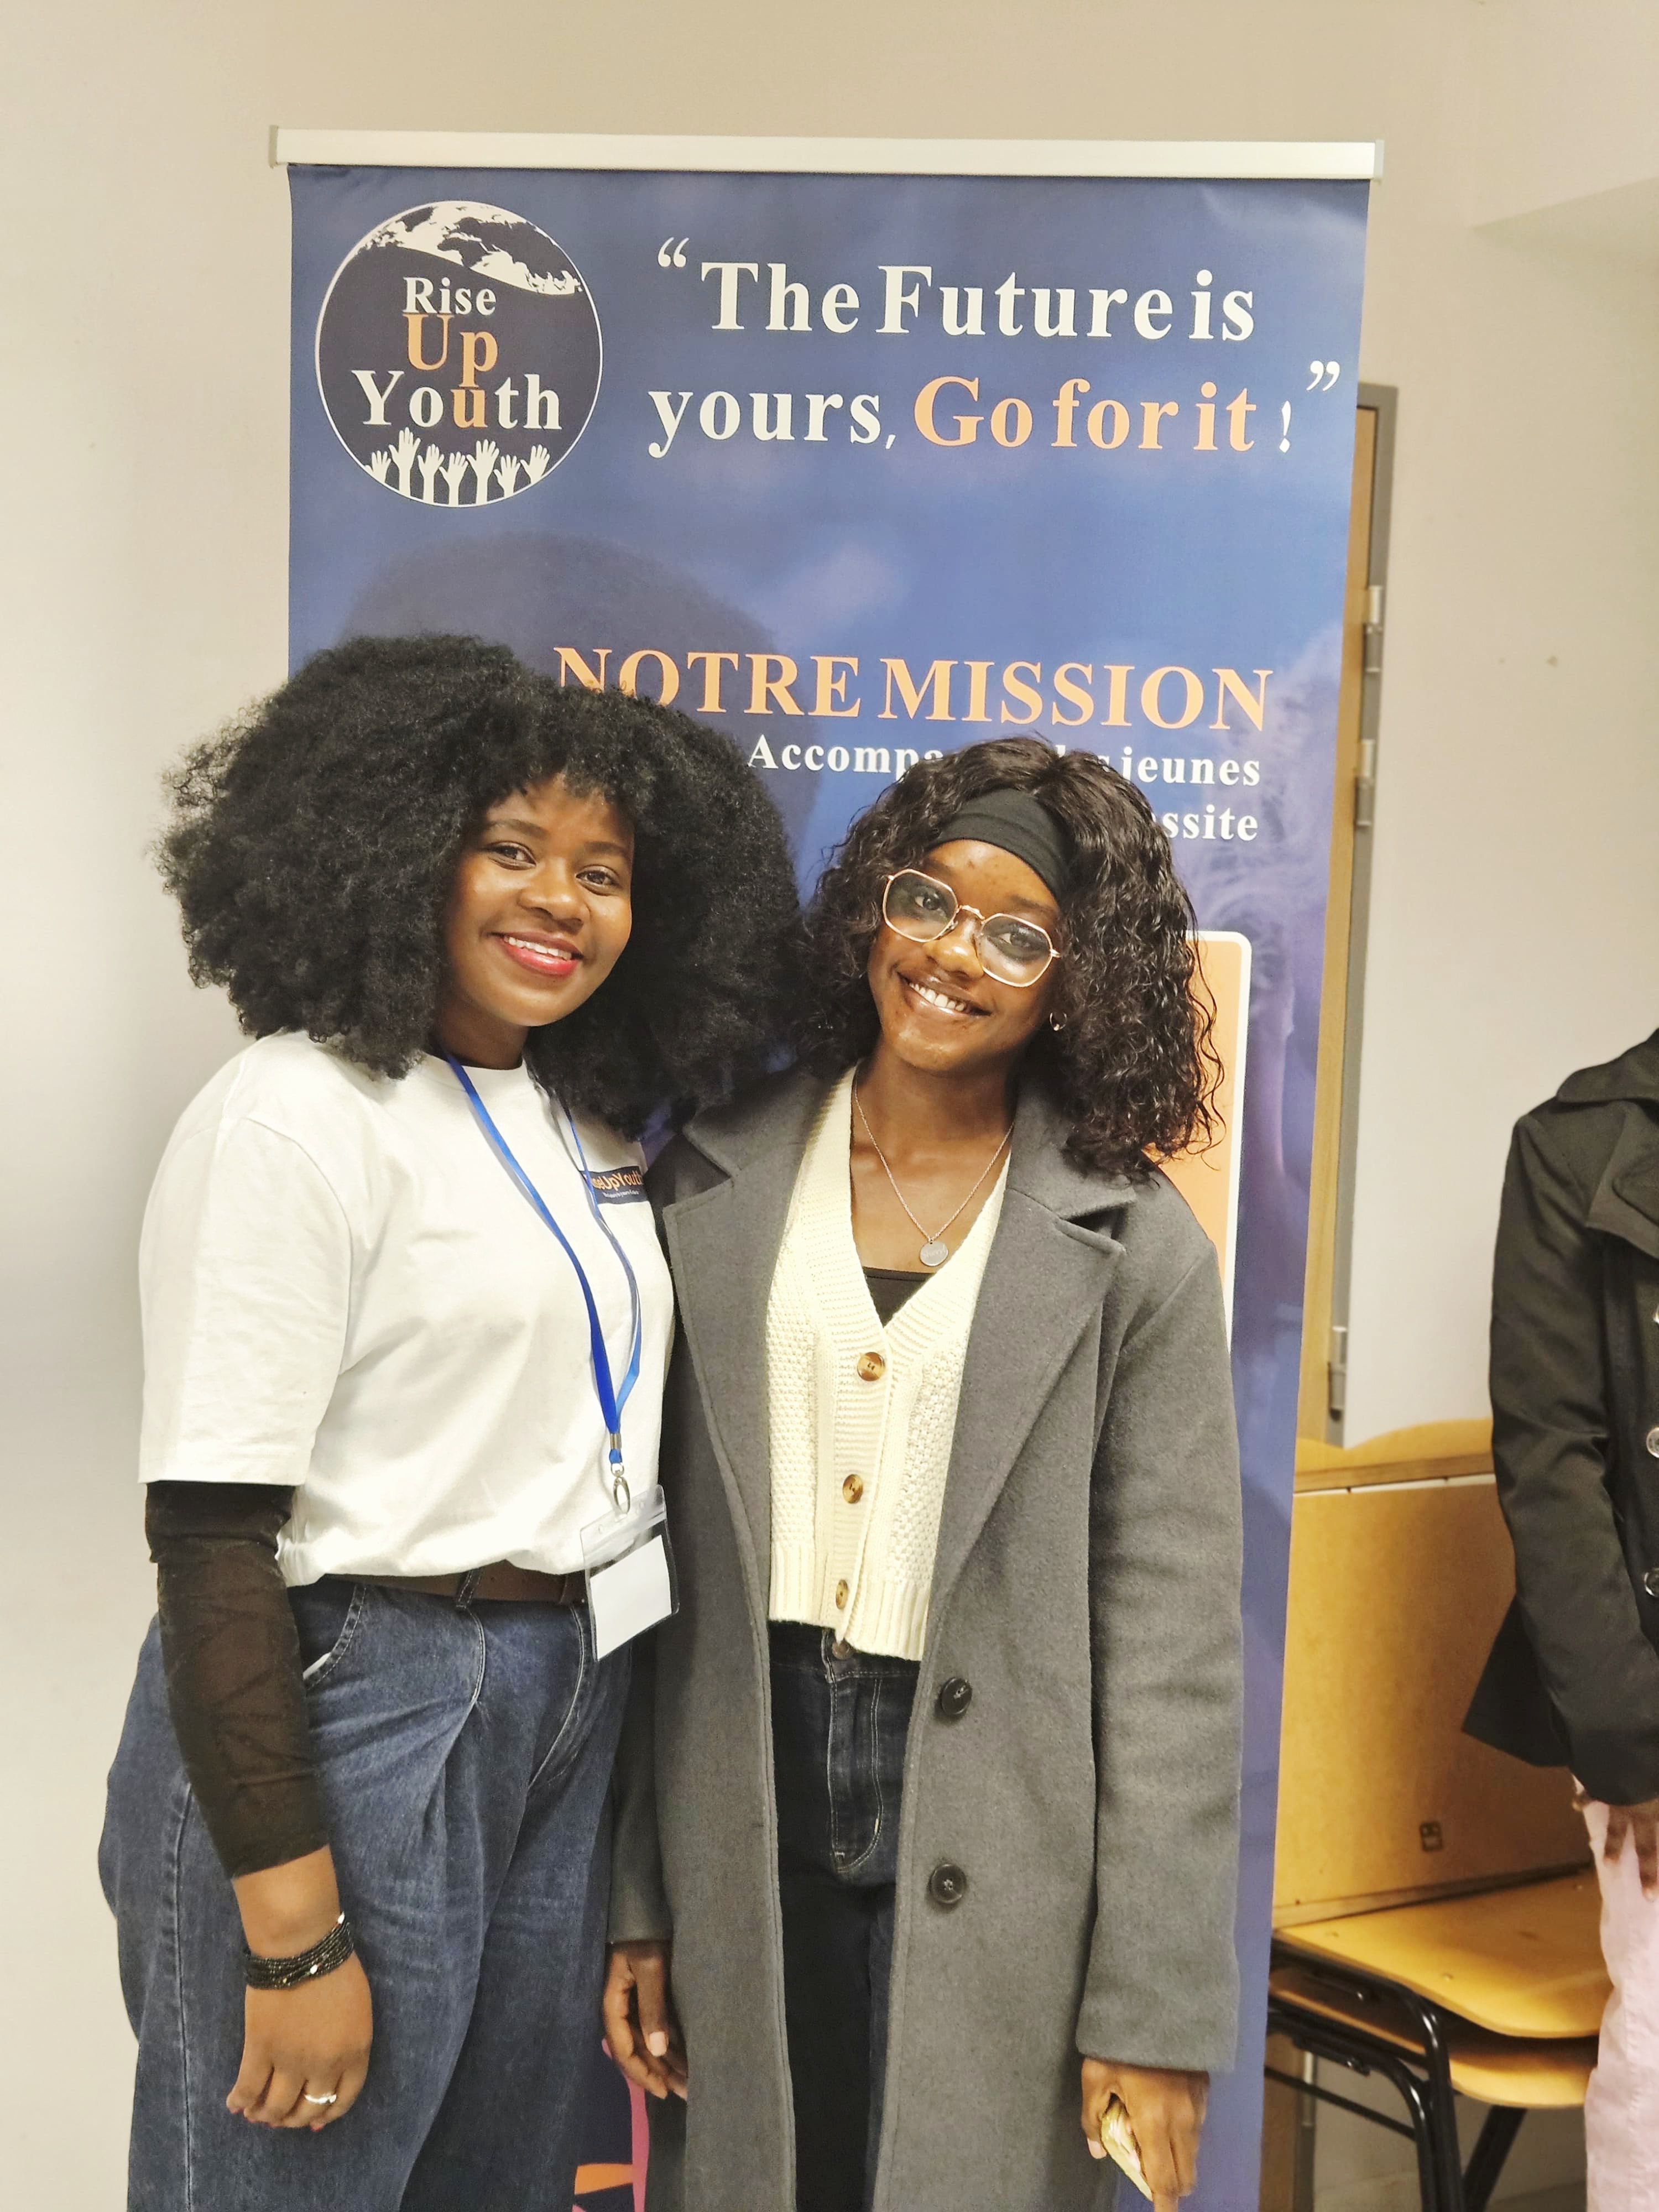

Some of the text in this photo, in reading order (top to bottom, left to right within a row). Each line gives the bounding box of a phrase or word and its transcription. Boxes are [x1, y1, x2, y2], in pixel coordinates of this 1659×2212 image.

[403, 277, 496, 315] Rise
[876, 266, 1172, 340] Future
[1189, 269, 1254, 341] is
[403, 314, 498, 387] Up
[351, 371, 562, 429] Youth
[648, 391, 895, 458] yours,
[914, 376, 1032, 447] Go
[1051, 378, 1178, 450] for
[1193, 382, 1256, 452] it
[554, 646, 1274, 731] NOTRE MISSION
[1121, 746, 1260, 786] jeunes
[1152, 805, 1258, 841] ssite
